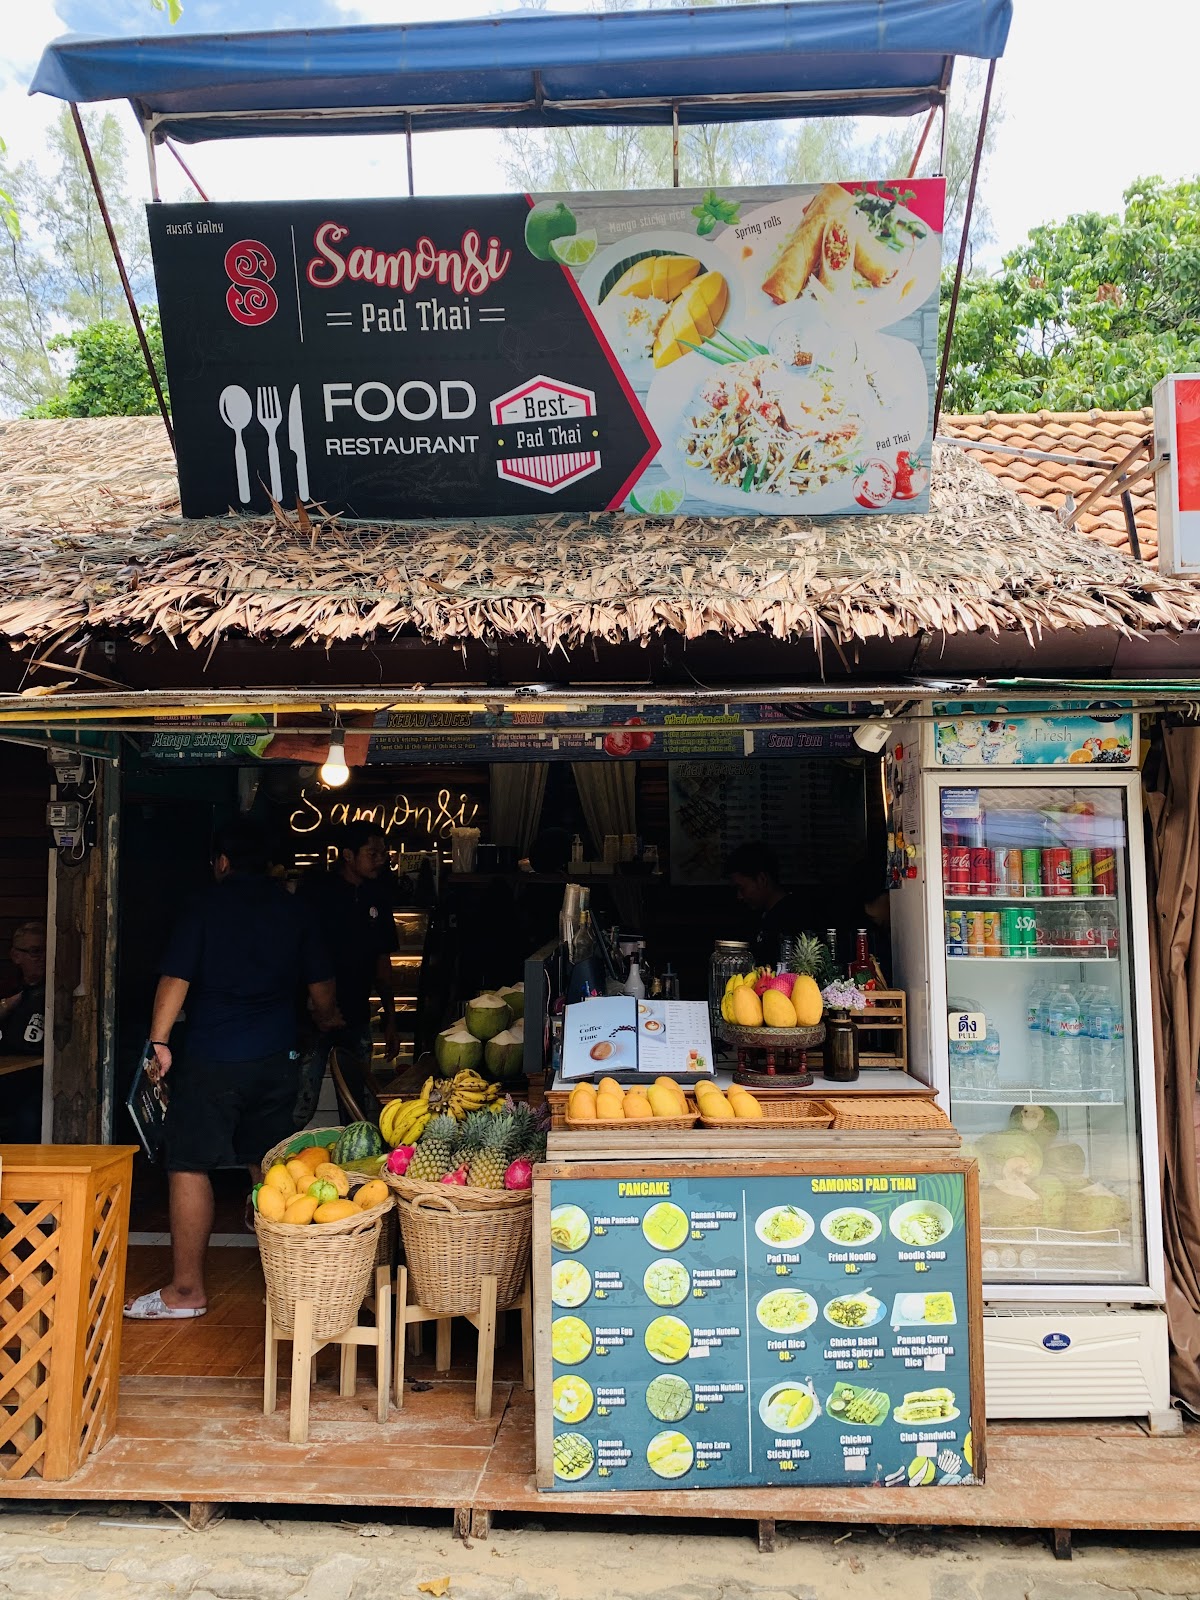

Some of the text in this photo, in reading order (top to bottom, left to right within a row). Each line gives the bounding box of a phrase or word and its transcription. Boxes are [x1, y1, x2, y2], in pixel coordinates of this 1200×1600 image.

[608, 209, 686, 233] Mango sticky rice
[196, 219, 224, 234] ผัดไทย
[734, 215, 782, 240] Spring rolls
[306, 221, 511, 294] Samonsi
[362, 299, 473, 333] Pad Thai
[322, 379, 477, 423] FOOD
[523, 394, 569, 419] Best
[516, 423, 582, 449] Pad Thai
[876, 430, 911, 450] Pad Thai
[326, 435, 479, 457] RESTAURANT
[387, 712, 473, 728] KEBAB SAUCES
[1035, 725, 1072, 742] Fresh
[152, 732, 257, 750] Mango sticky rice
[290, 788, 478, 839] Samonsi
[958, 1014, 977, 1032] ดึง
[579, 1025, 602, 1034] Coffee
[618, 1182, 671, 1196] PANCAKE
[811, 1177, 917, 1193] SAMONSI PAD THAI
[594, 1216, 639, 1225] Plain Pancake
[690, 1211, 737, 1220] Banana Honey
[691, 1221, 719, 1229] Pancake
[766, 1254, 800, 1263] Pad Thai
[828, 1252, 876, 1262] Fried Noodle
[898, 1251, 946, 1261] Noodle Soup
[775, 1265, 791, 1275] 80.-
[844, 1264, 860, 1274] 80.-
[914, 1261, 930, 1271] 80.-
[594, 1271, 619, 1279] Banana
[692, 1269, 737, 1278] Peanut Butter
[594, 1280, 622, 1288] Pancake
[692, 1279, 720, 1287] Pancake
[595, 1327, 633, 1336] Banana Egg
[694, 1327, 740, 1337] Mango Nutella
[595, 1337, 624, 1345] Pancake
[694, 1338, 722, 1346] Pancake
[767, 1340, 805, 1350] Fried Rice
[830, 1337, 878, 1347] Chicke Basil
[897, 1335, 948, 1345] Panang Curry
[778, 1351, 794, 1361] 80.-
[824, 1349, 884, 1359] Leaves Spicy on
[892, 1347, 910, 1356] With
[911, 1346, 942, 1356] Chicken
[836, 1359, 873, 1370] Rice 80.-
[904, 1358, 922, 1367] Rice
[597, 1388, 624, 1396] Coconut
[695, 1384, 719, 1392] Banana
[597, 1397, 625, 1405] Pancake
[695, 1394, 723, 1402] Pancake
[839, 1435, 871, 1444] Chicken
[900, 1431, 956, 1442] Club Sandwich
[597, 1440, 622, 1448] Banana
[696, 1441, 731, 1450] More Extra
[775, 1439, 801, 1448] Mango
[598, 1449, 631, 1457] Chocolate
[696, 1451, 721, 1459] Cheese
[766, 1449, 810, 1460] Sticky Rice
[843, 1447, 870, 1456] Satays
[779, 1461, 799, 1471] 100.-
